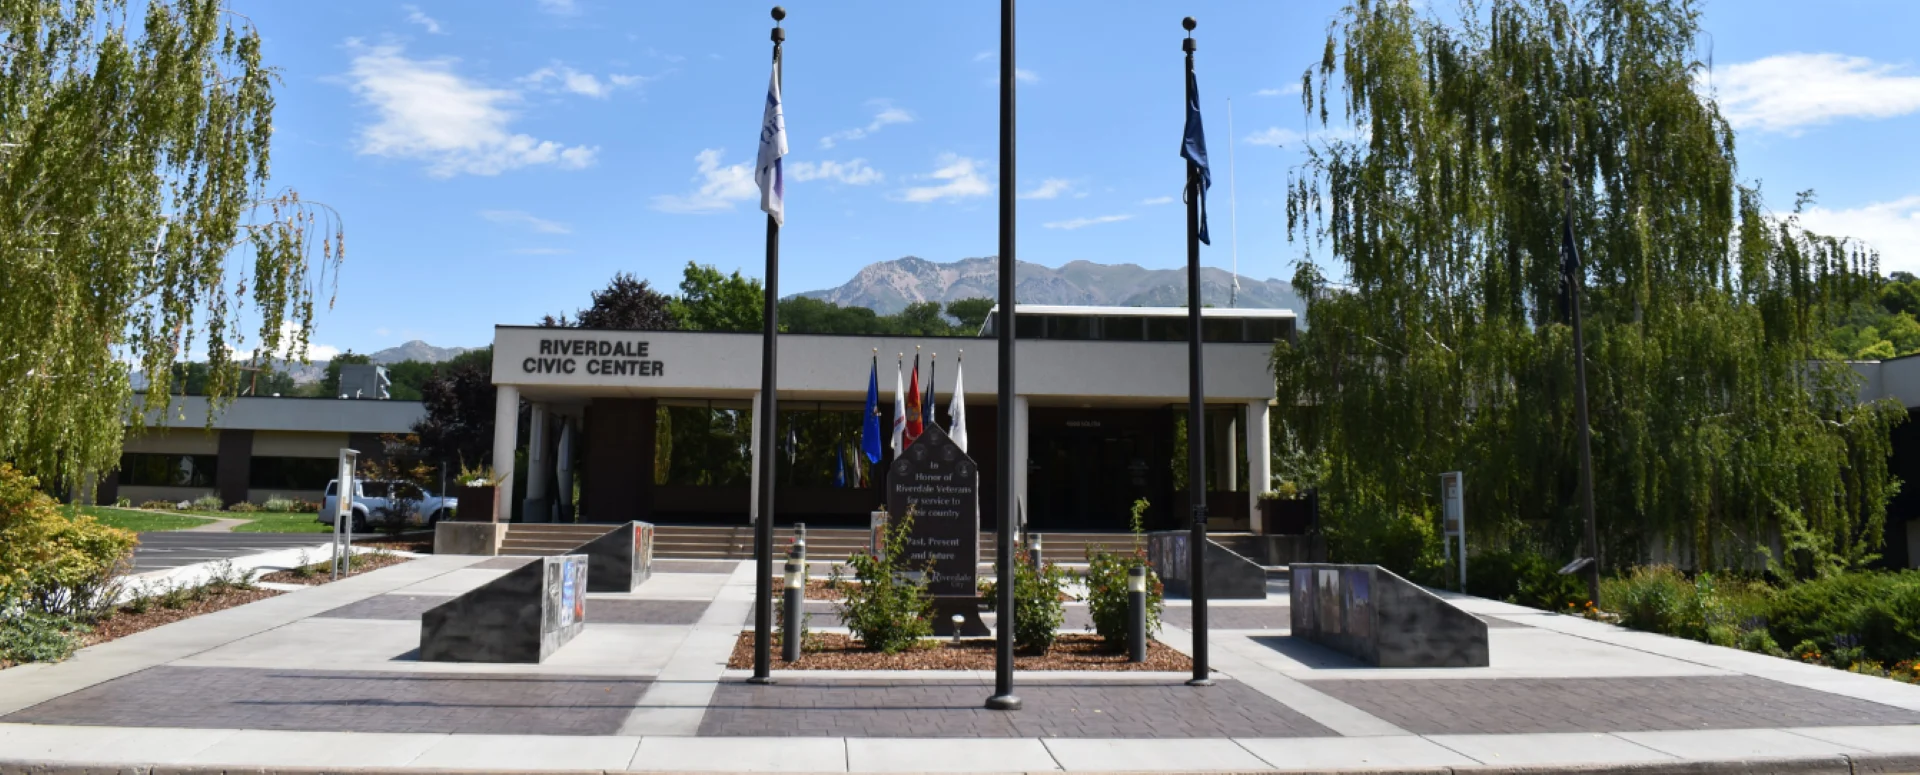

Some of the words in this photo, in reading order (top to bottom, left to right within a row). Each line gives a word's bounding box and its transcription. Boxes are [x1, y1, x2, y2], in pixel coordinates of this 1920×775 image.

[539, 339, 649, 357] RIVERDALE
[522, 358, 577, 374] CIVIC
[586, 359, 664, 377] CENTER
[930, 461, 939, 469] In
[915, 473, 942, 481] Honor
[943, 473, 953, 481] of
[896, 484, 935, 493] Riverdale
[936, 485, 972, 494] Veterans
[921, 496, 950, 505] service
[952, 497, 961, 505] to
[927, 510, 960, 519] country
[928, 537, 960, 546] Present
[910, 551, 926, 560] and
